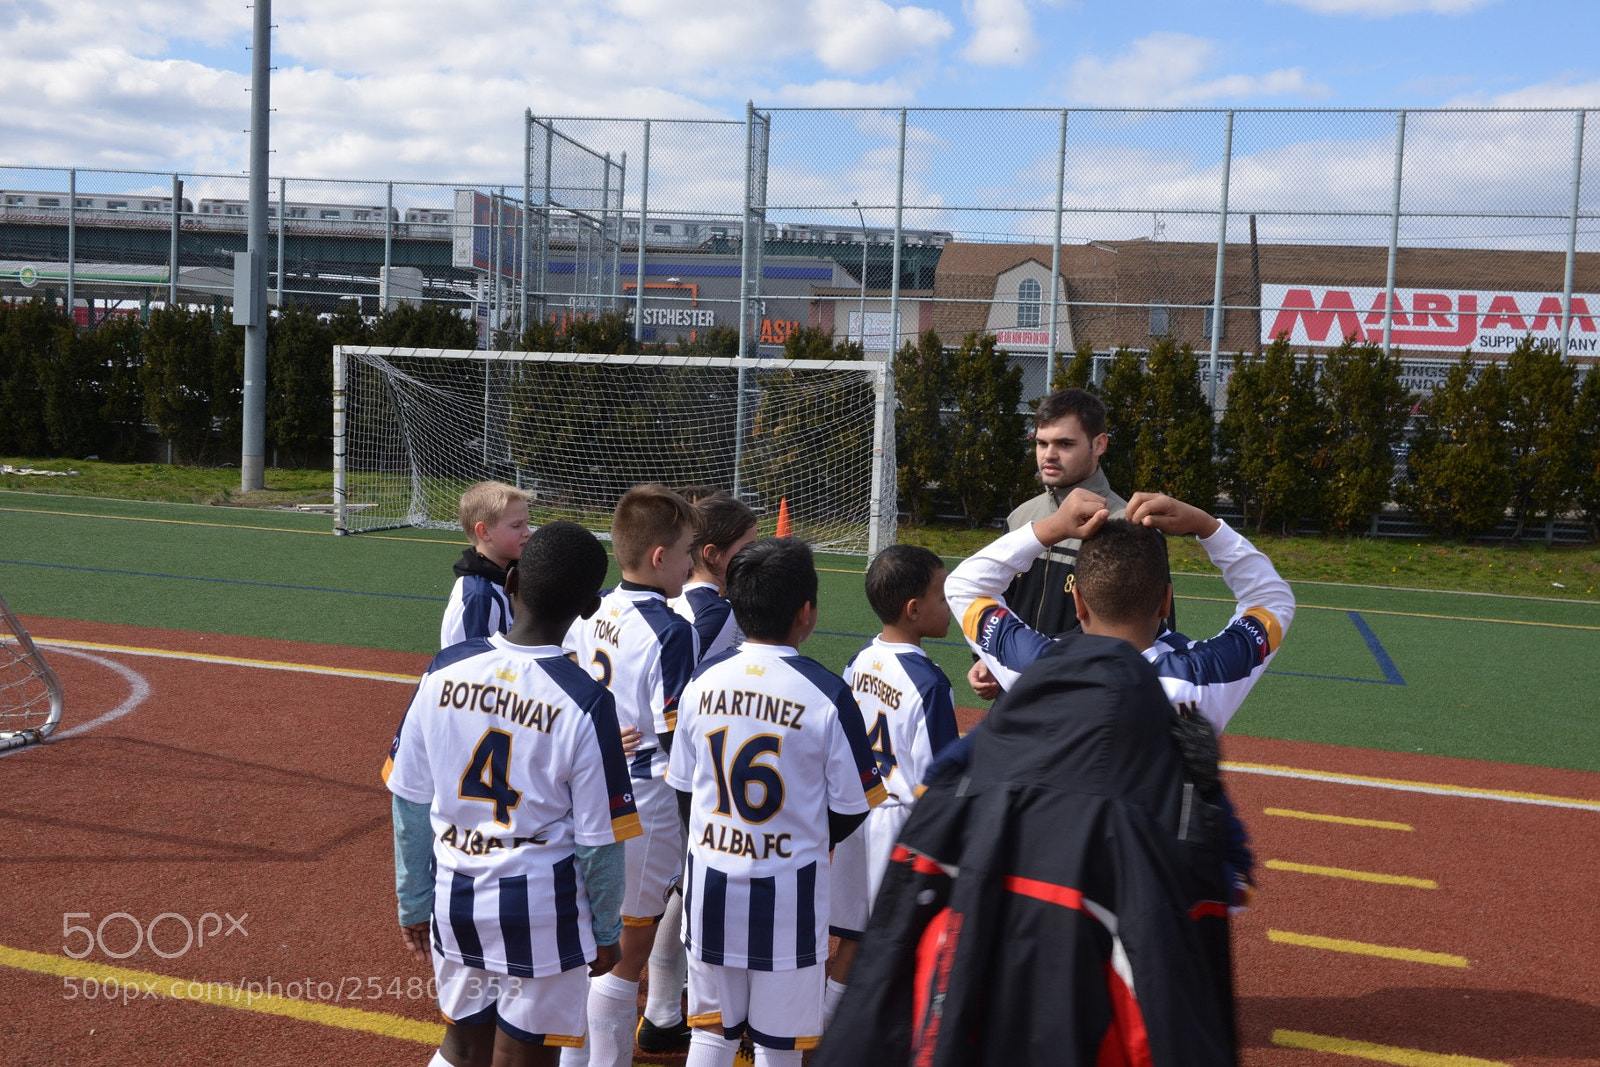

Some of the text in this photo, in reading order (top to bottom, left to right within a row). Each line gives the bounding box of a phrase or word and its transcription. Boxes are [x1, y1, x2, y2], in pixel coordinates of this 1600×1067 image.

[625, 307, 715, 327] WSTCHESTER
[750, 318, 800, 344] ASH
[1267, 289, 1598, 347] MARJAM
[1531, 336, 1597, 350] COMANY
[593, 619, 622, 648] TOMA
[438, 679, 562, 734] BOTCHWAY
[698, 689, 806, 731] MARTINEZ
[457, 726, 524, 829] 4
[705, 725, 785, 826] 16
[440, 823, 505, 857] ALBA
[699, 822, 794, 860] ALBA FC
